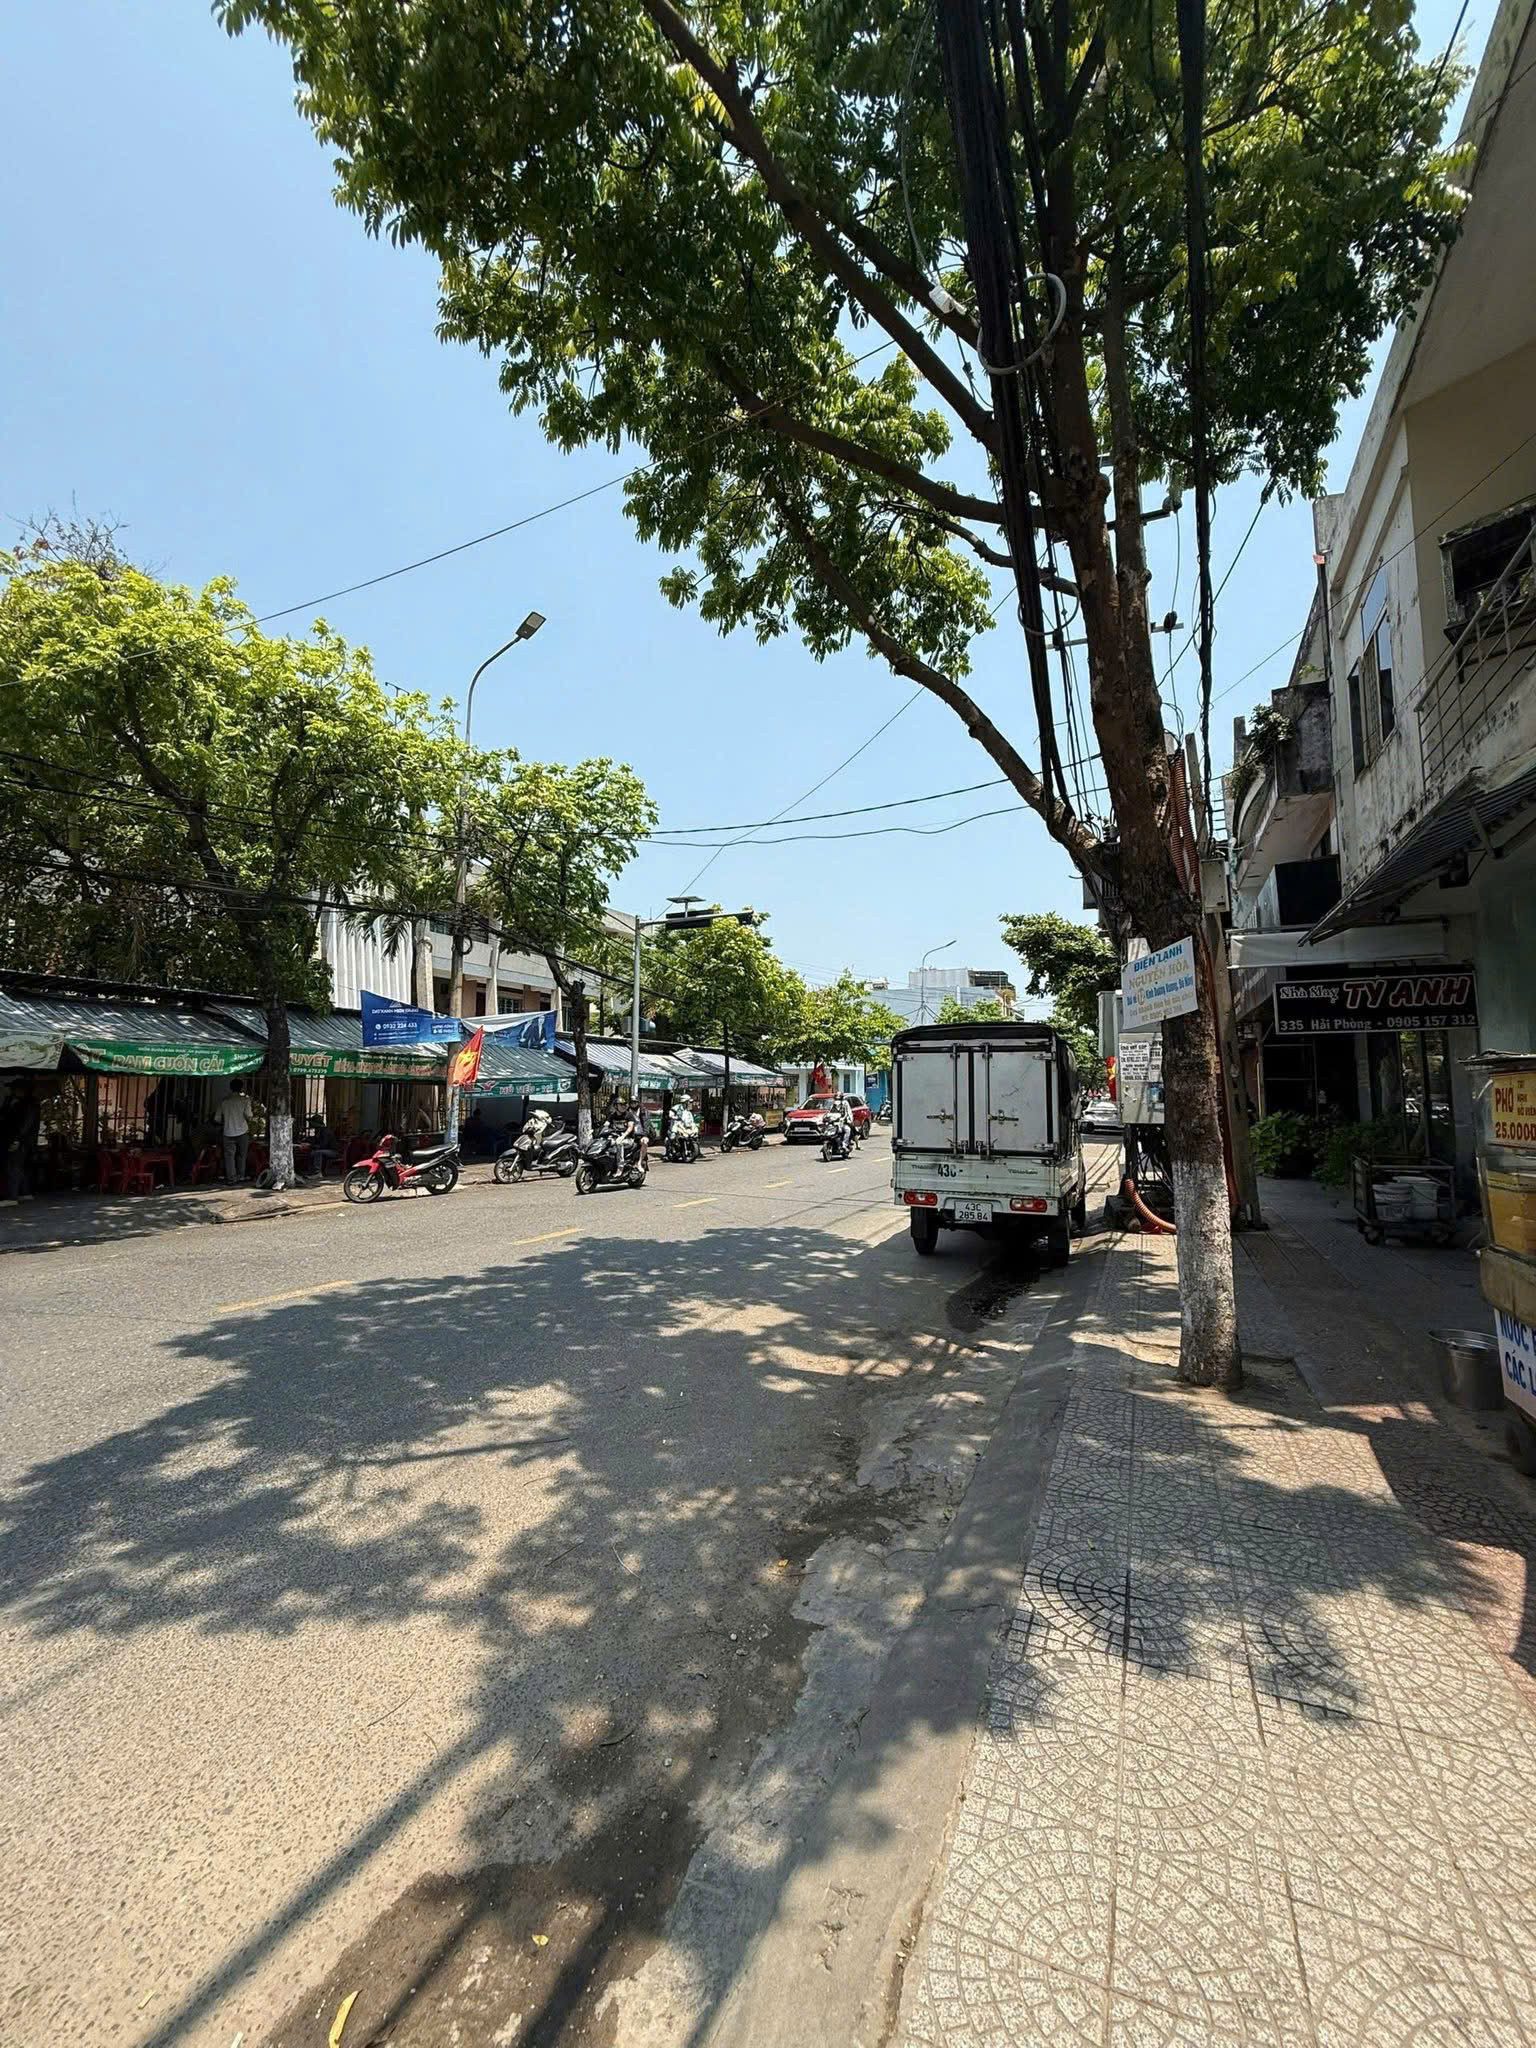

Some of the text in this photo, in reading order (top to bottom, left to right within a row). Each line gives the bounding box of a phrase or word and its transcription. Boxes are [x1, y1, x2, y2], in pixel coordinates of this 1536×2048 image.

[1389, 976, 1472, 1007] ANH
[1280, 1020, 1304, 1031] 335
[1311, 1018, 1330, 1030] Hải
[1334, 1017, 1372, 1031] Phòng
[1387, 1016, 1421, 1028] 0905
[1424, 1016, 1447, 1028] 157
[1452, 1014, 1476, 1026] 312
[965, 1203, 981, 1211] 43C
